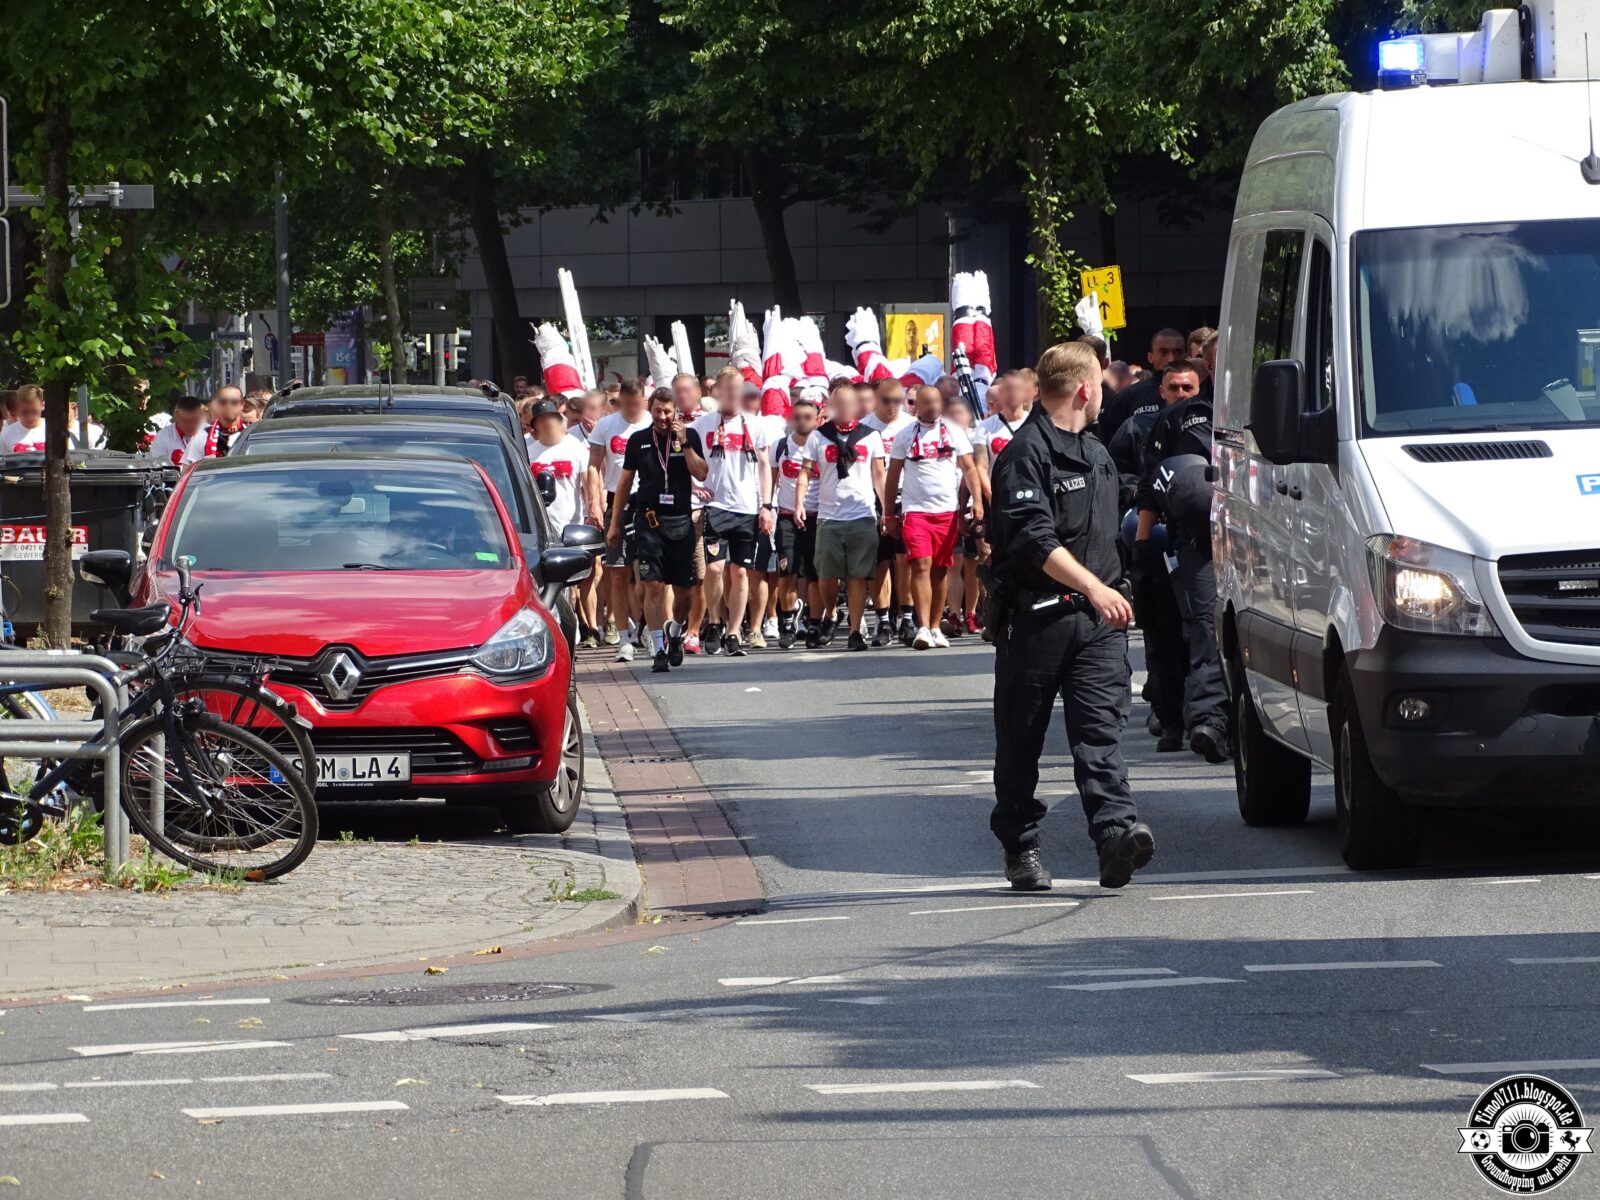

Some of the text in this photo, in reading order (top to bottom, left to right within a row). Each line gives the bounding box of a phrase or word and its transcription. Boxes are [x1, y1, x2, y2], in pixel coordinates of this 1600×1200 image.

[1107, 271, 1115, 285] 3
[352, 757, 381, 779] LA
[387, 757, 401, 778] 4
